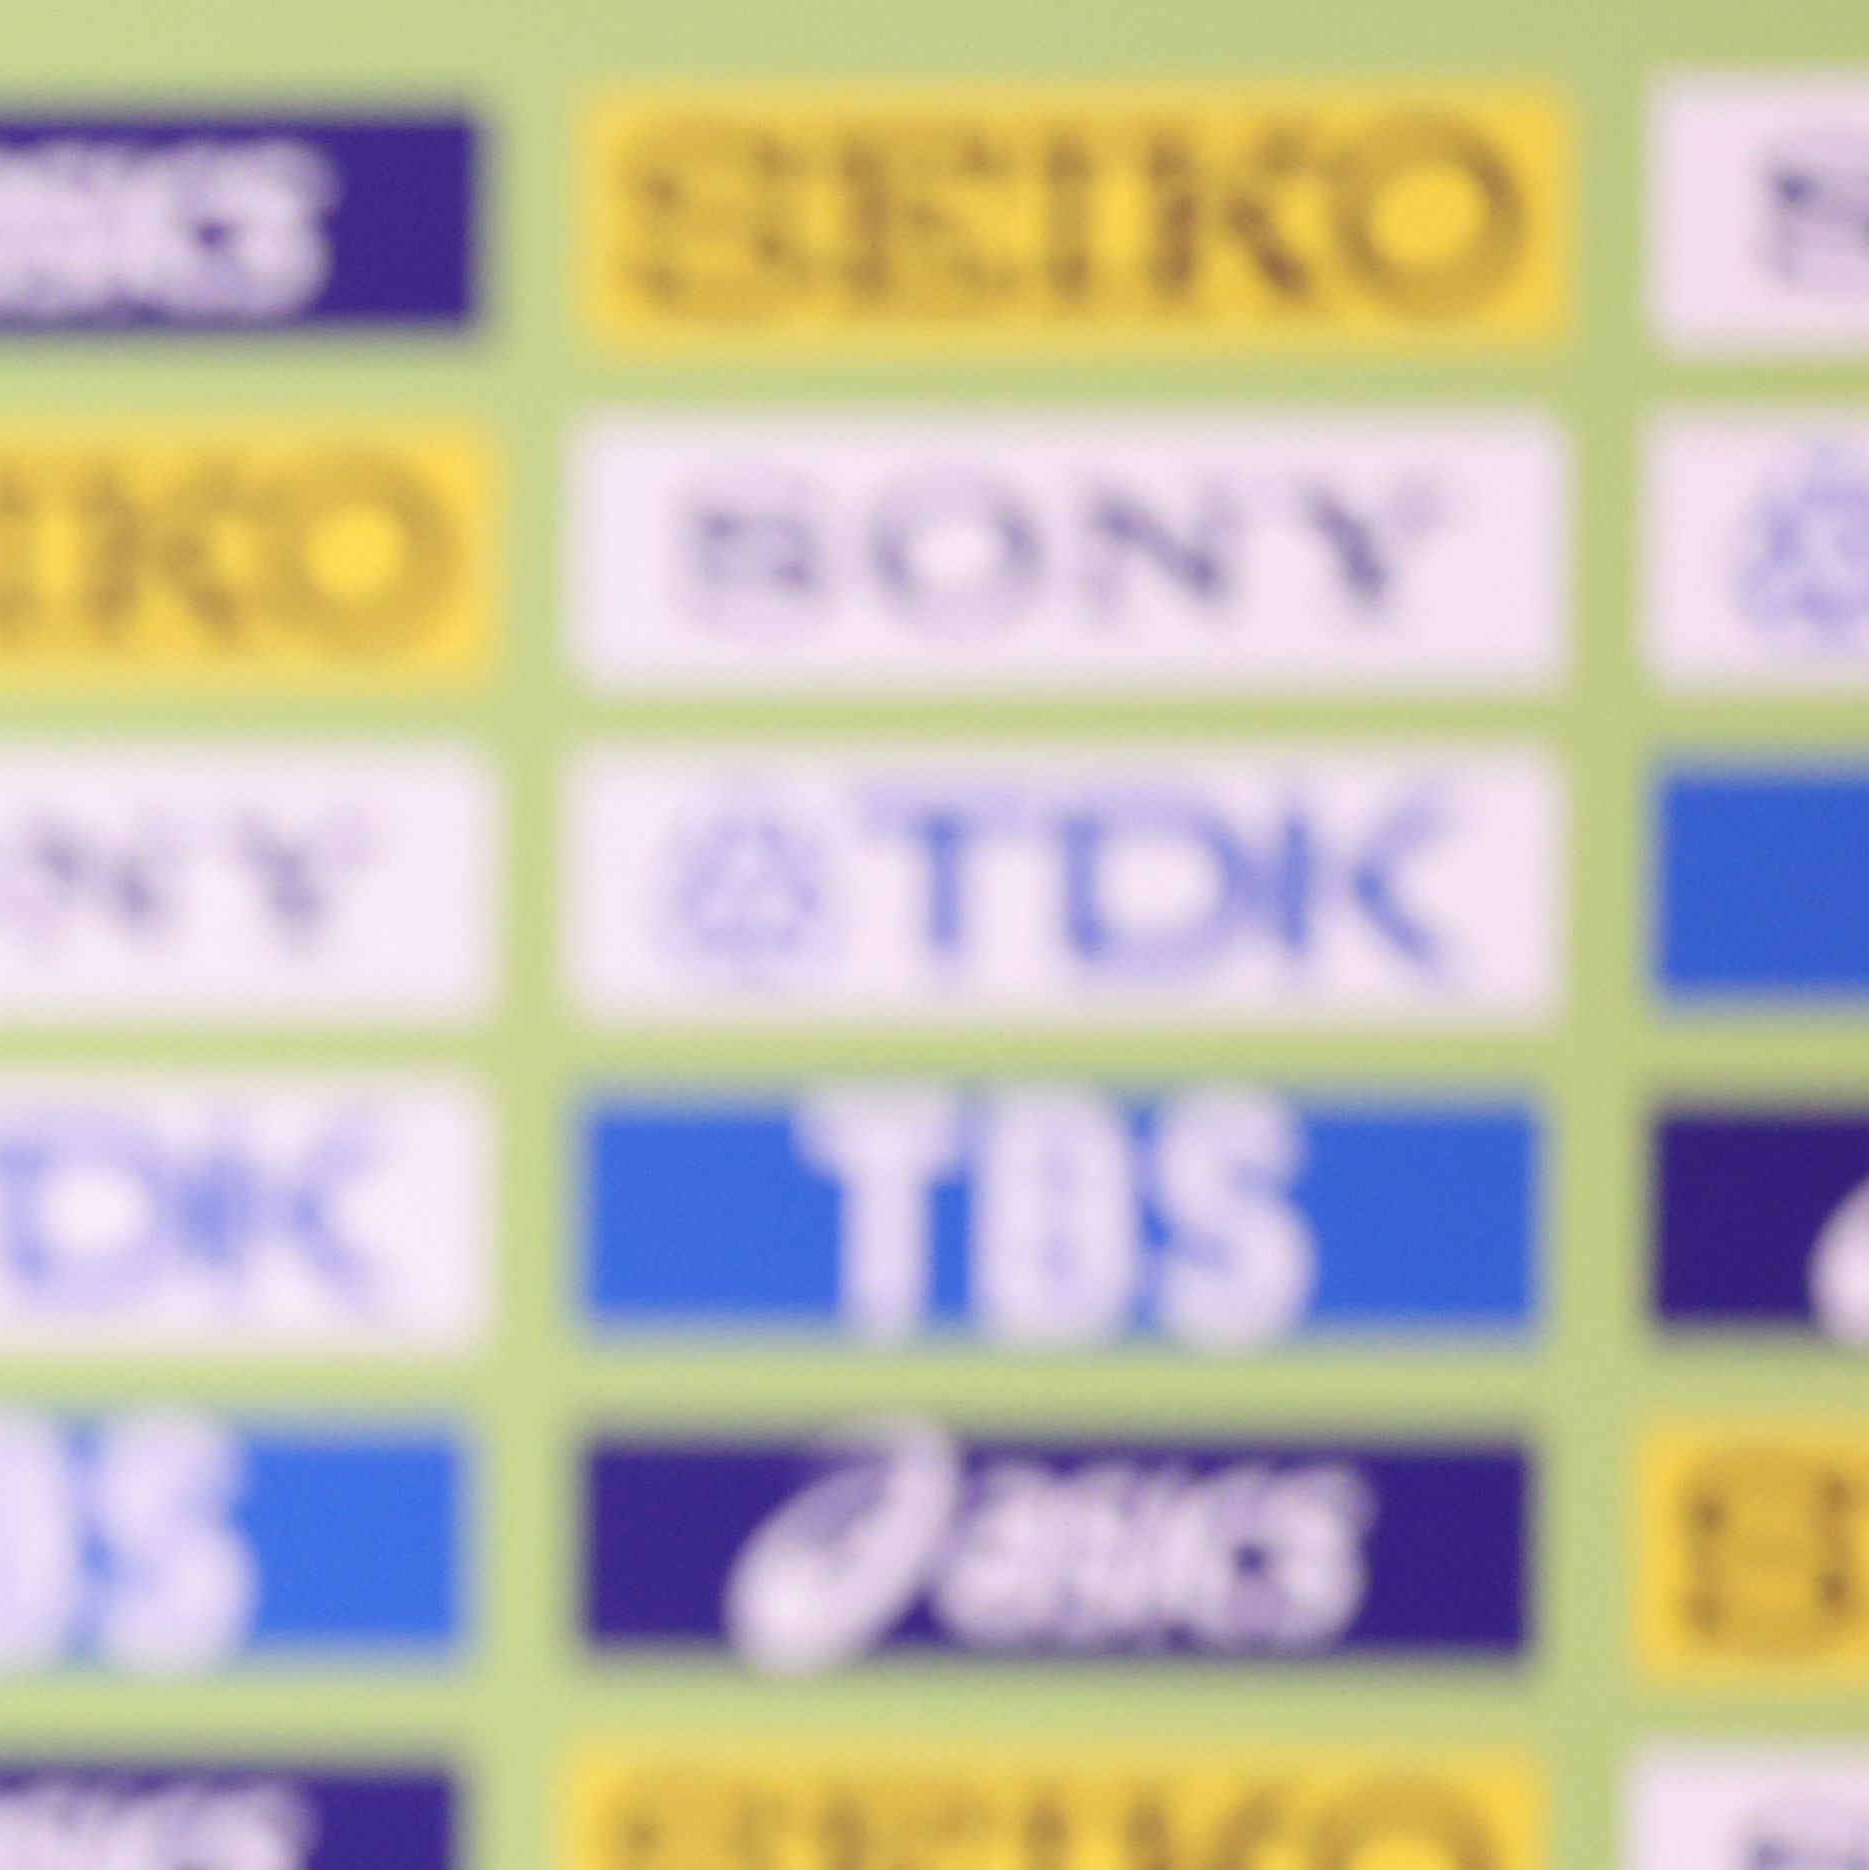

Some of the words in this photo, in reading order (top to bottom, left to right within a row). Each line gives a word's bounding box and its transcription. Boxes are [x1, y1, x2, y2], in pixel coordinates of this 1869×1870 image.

[610, 104, 1529, 330] SEIKO
[671, 476, 1445, 616] SONY
[850, 789, 1469, 975] TDK
[794, 1085, 1309, 1345] TBS
[933, 1458, 1371, 1648] asics
